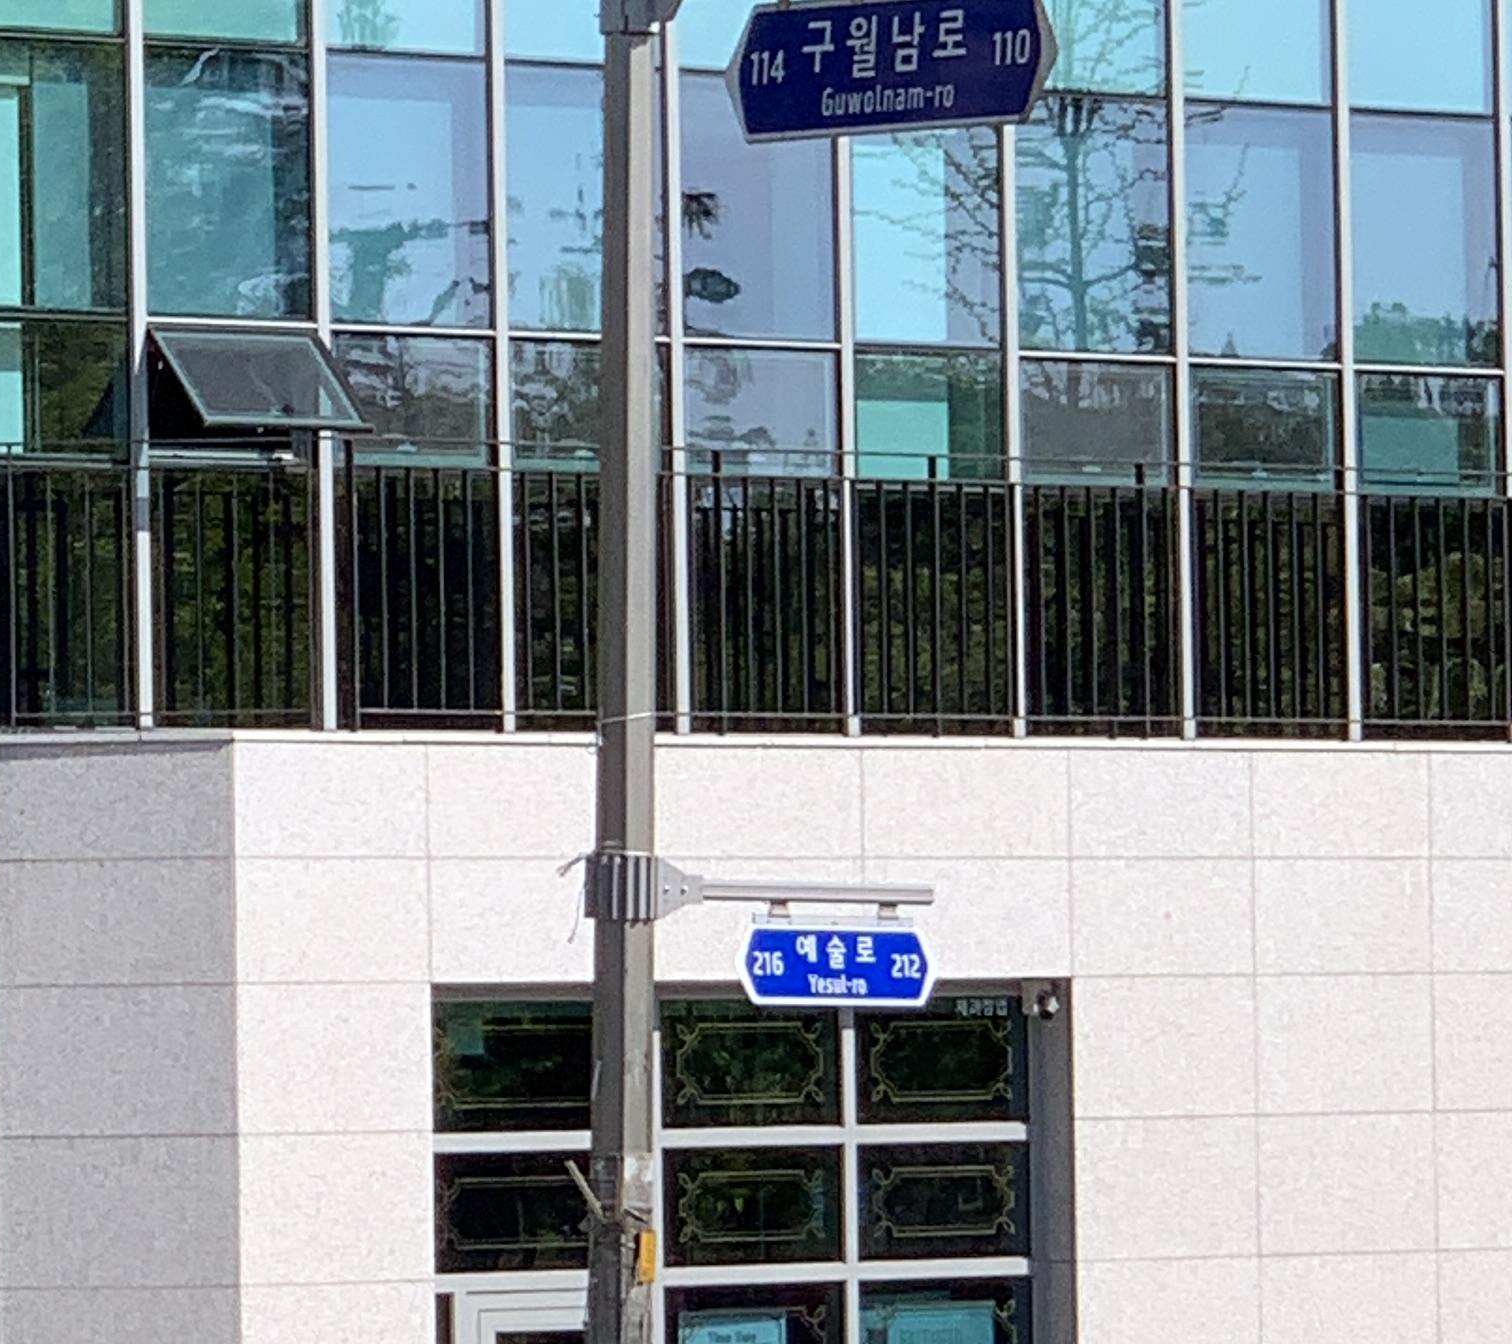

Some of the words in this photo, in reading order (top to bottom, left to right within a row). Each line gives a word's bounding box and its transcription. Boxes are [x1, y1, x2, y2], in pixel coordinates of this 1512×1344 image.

[750, 50, 786, 85] 114
[801, 8, 969, 79] 구월남로
[992, 28, 1032, 66] 110
[820, 83, 956, 117] Guwolnam-ro
[751, 950, 786, 978] 216
[794, 933, 877, 971] 예술로
[890, 952, 923, 980] 212
[806, 972, 869, 996] Yesul-ro
